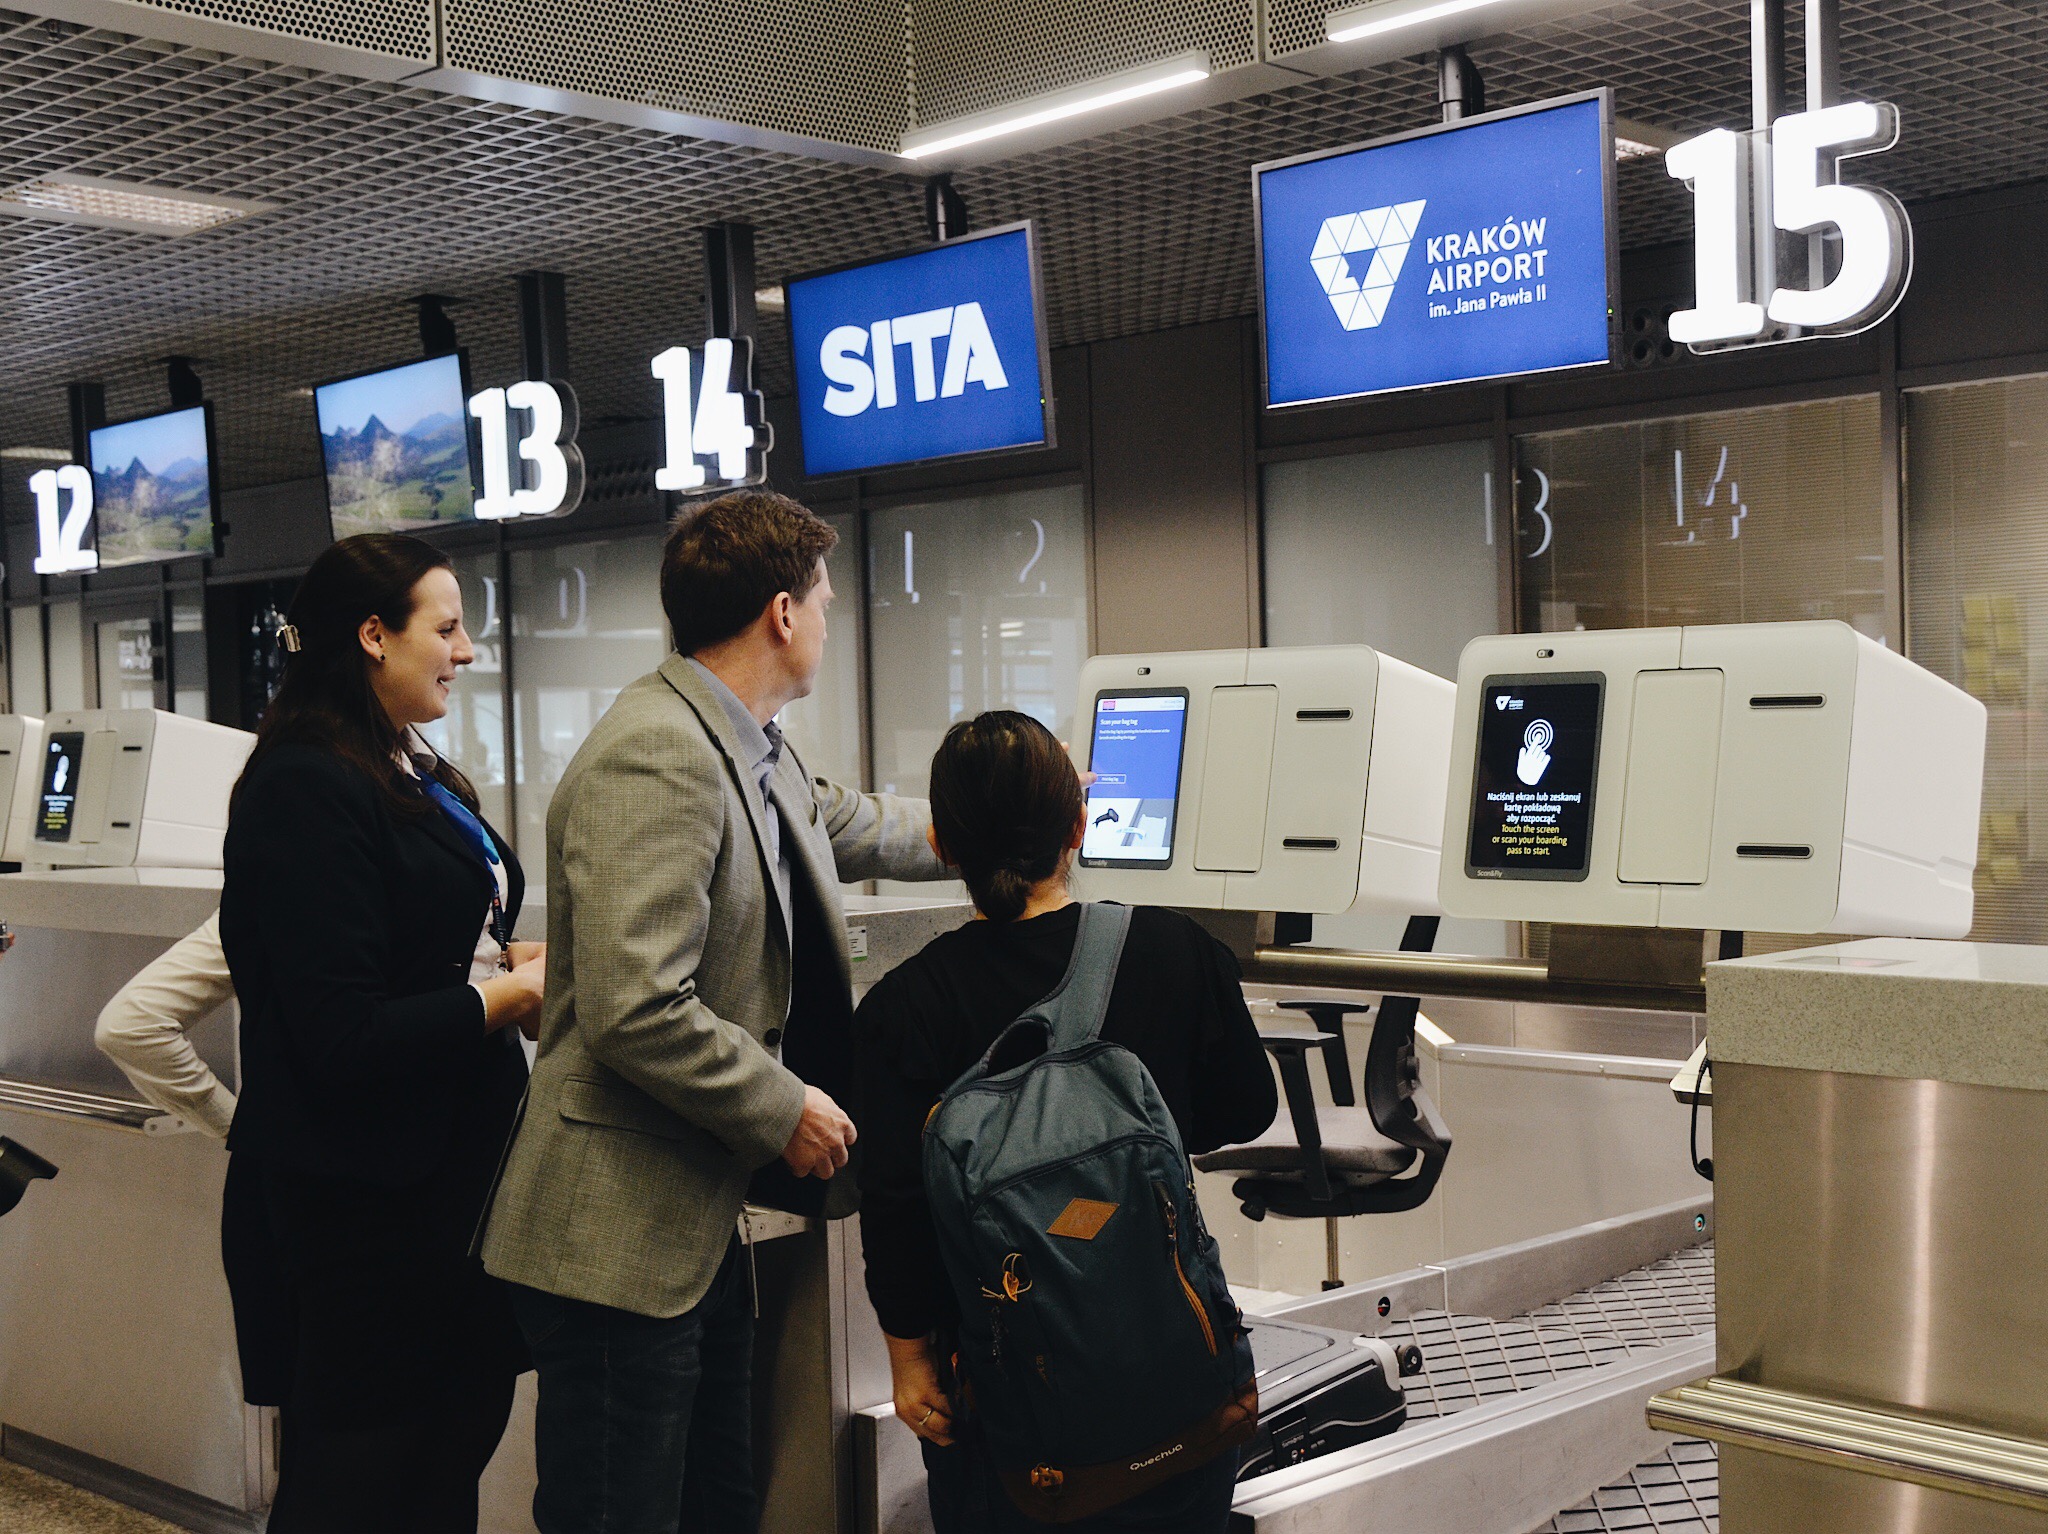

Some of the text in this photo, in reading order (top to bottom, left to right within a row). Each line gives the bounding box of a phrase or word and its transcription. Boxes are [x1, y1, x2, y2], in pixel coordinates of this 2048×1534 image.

[1426, 215, 1546, 265] KRAKÓW
[1665, 101, 1892, 344] 15
[1426, 249, 1548, 295] AIRPORT
[1428, 283, 1546, 318] im. Jana Pawła II
[819, 301, 1010, 417] SITA
[651, 337, 755, 491] 14
[468, 380, 569, 520] 13
[29, 464, 98, 575] 12
[1487, 792, 1581, 803] Naciśnij ekran lub zeskanuj
[1503, 803, 1522, 813] kartę
[1501, 824, 1559, 834] Touch the screen
[1505, 814, 1519, 824] aby
[1491, 836, 1568, 847] or scan your boarding
[1506, 847, 1551, 856] pass to start.
[1129, 1443, 1184, 1471] Quechua
